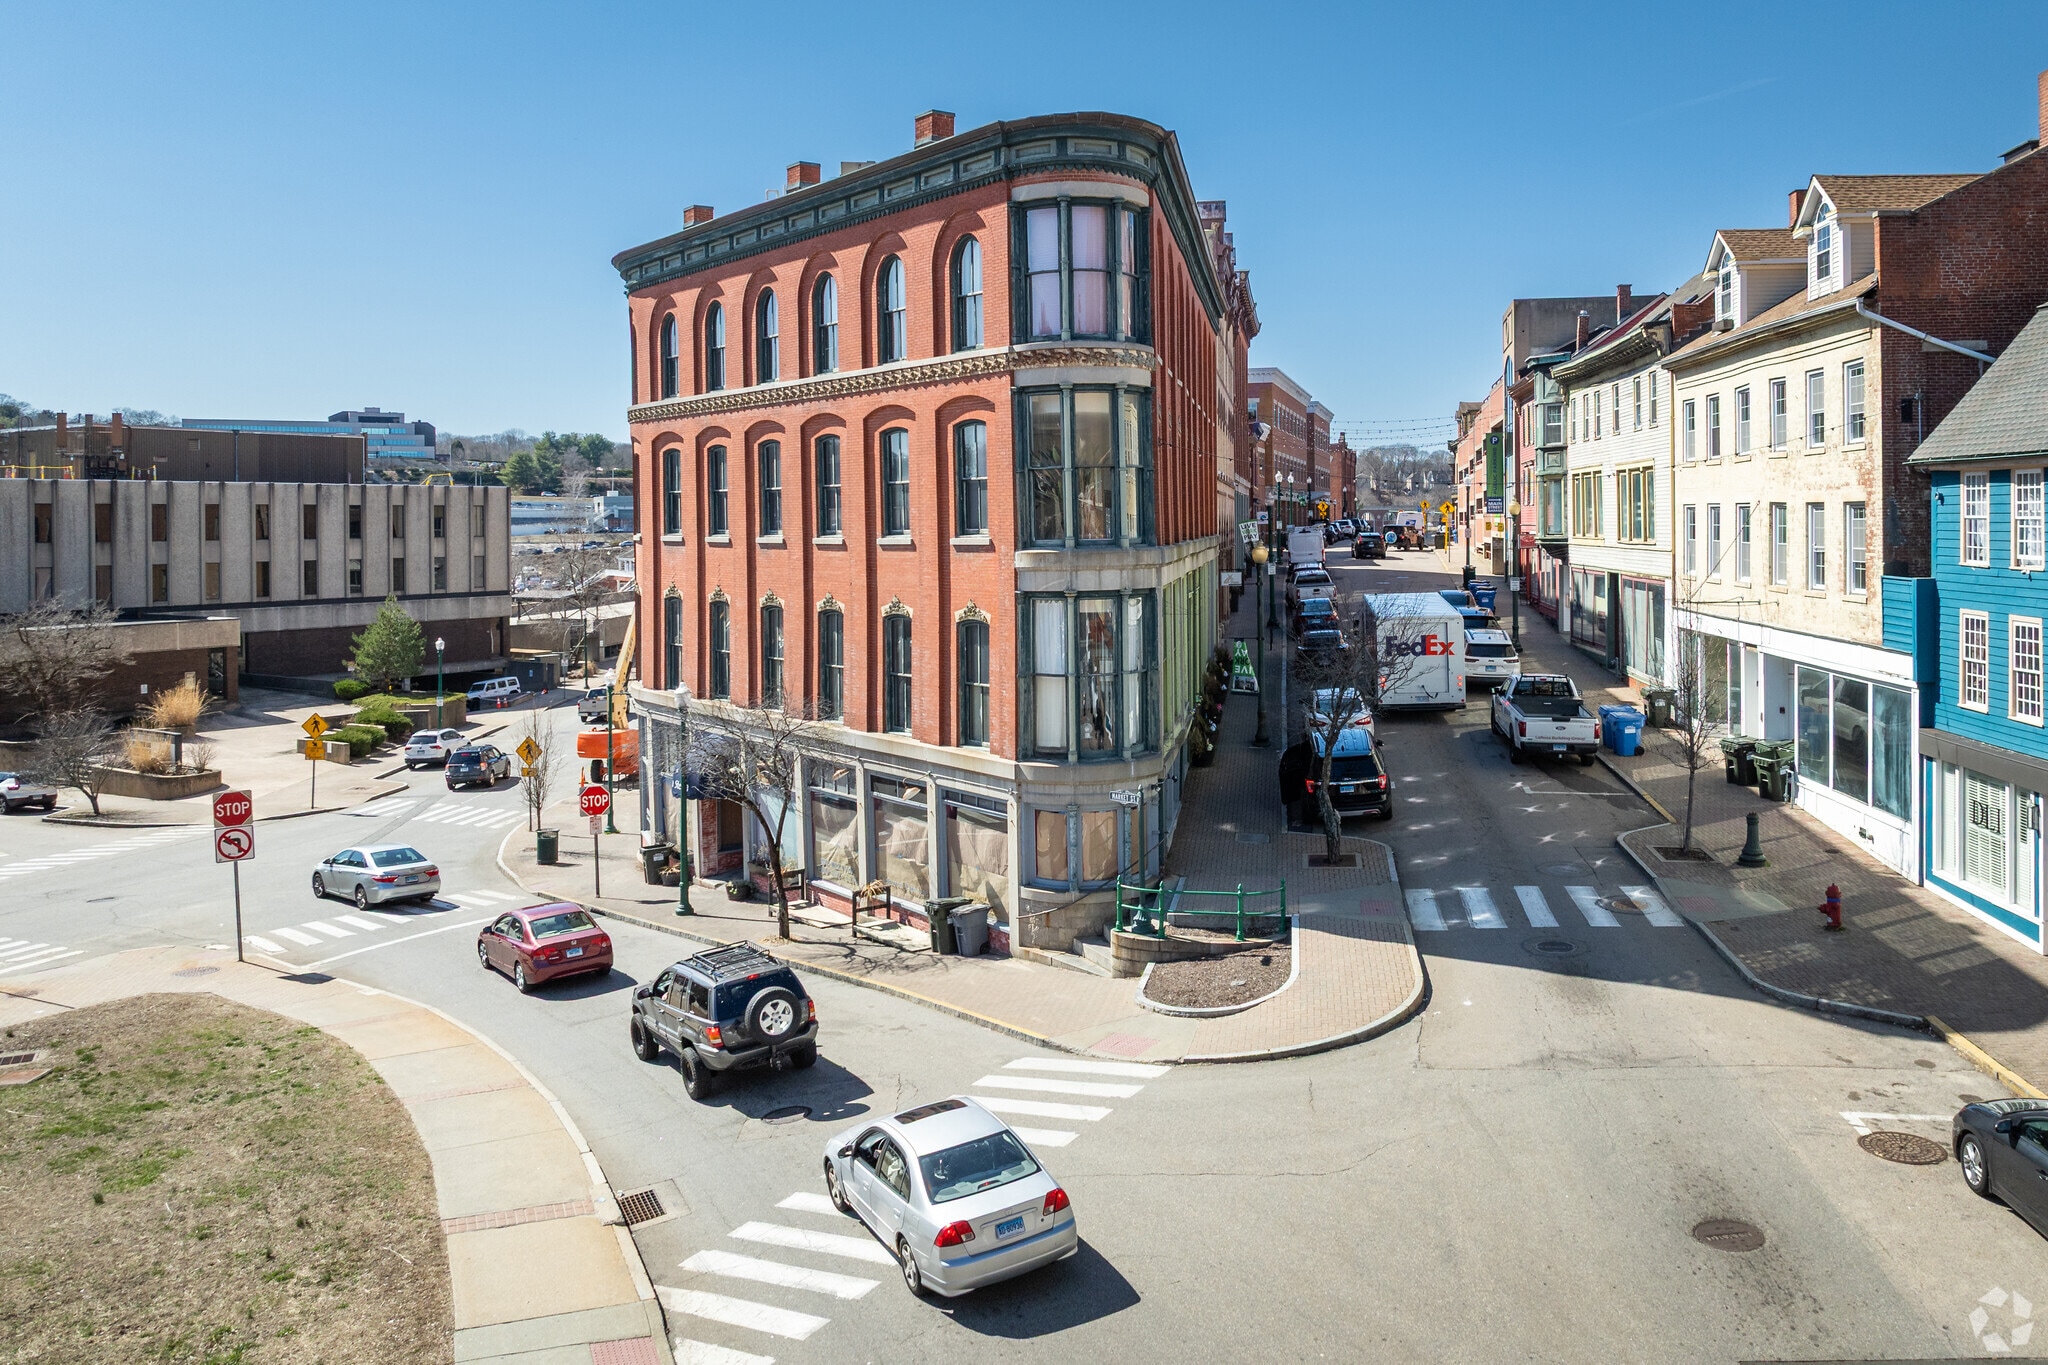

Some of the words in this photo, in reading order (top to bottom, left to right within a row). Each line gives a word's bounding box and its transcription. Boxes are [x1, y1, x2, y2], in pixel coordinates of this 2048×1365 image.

[1240, 522, 1256, 530] LIVE
[1386, 634, 1455, 656] FedEx
[582, 794, 608, 808] STOP
[1112, 793, 1129, 801] MARKET
[216, 801, 250, 817] STOP
